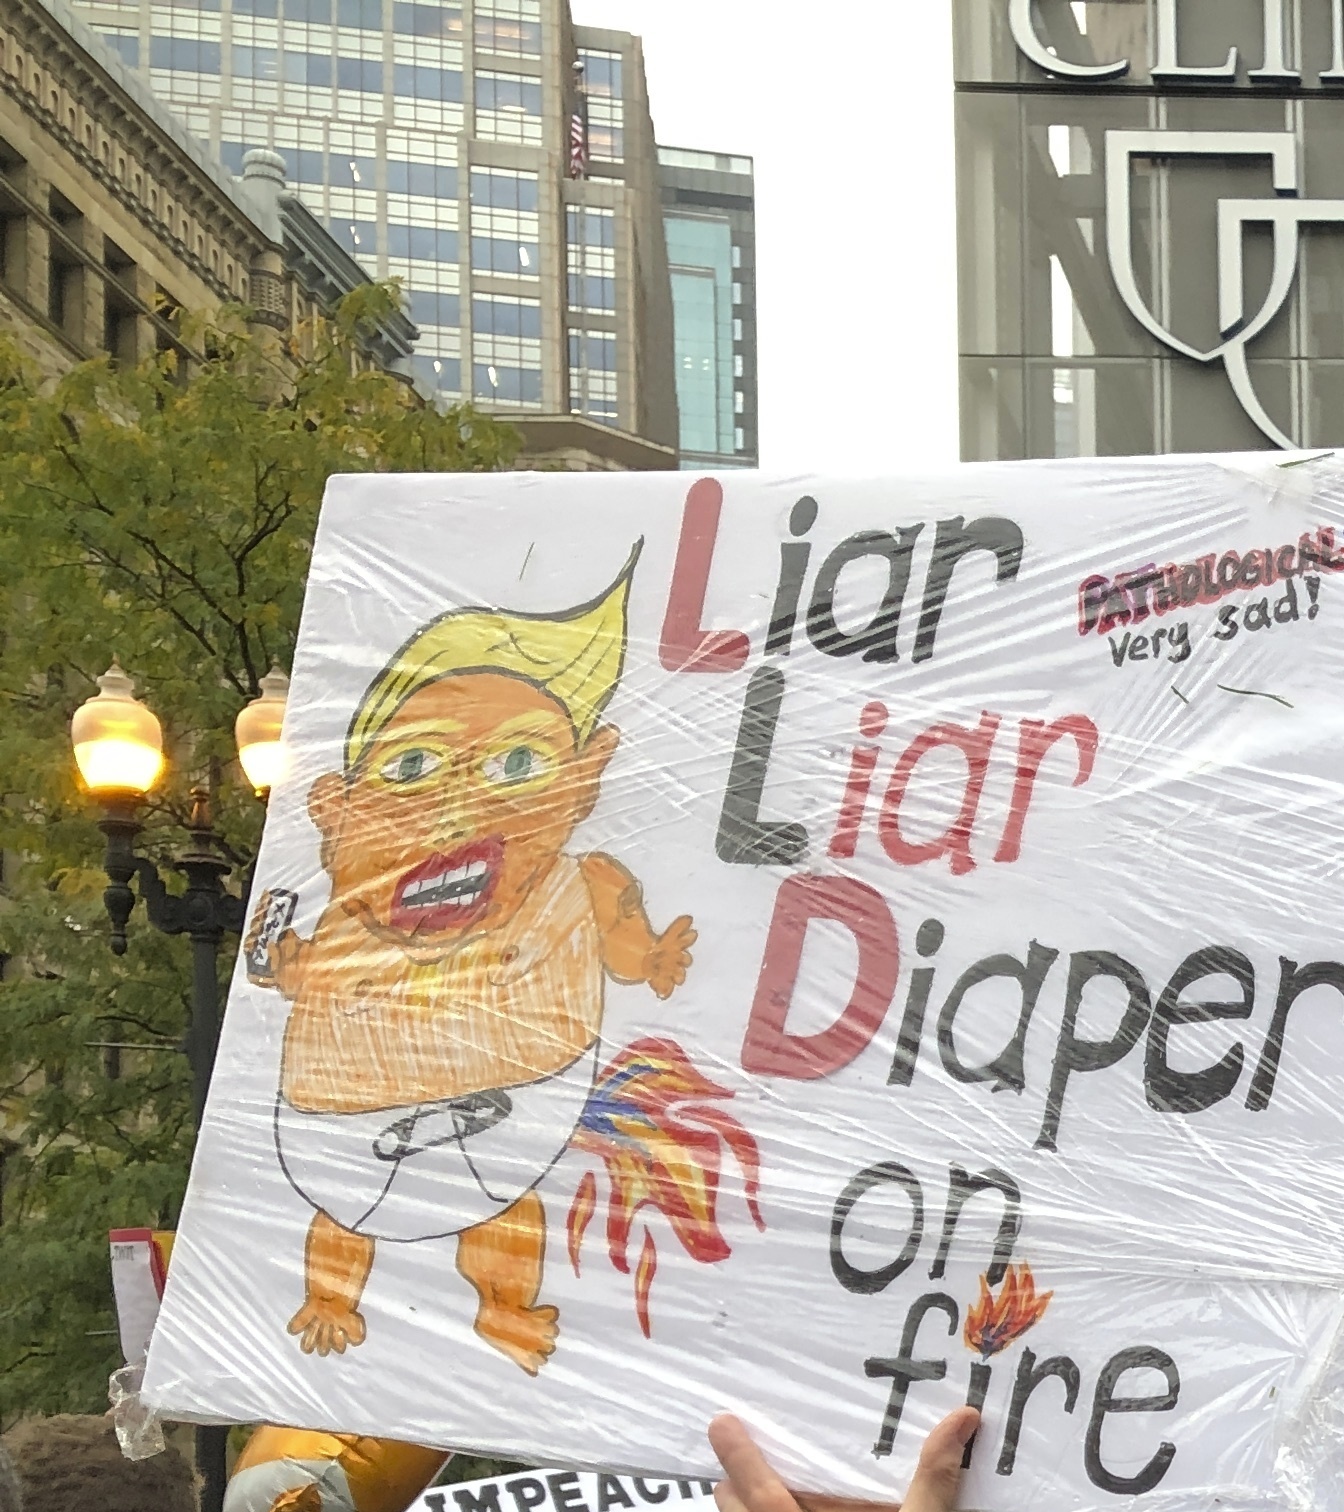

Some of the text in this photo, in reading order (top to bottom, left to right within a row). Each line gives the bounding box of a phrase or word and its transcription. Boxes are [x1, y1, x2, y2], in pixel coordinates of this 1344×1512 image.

[657, 476, 1025, 674] Liar
[1108, 574, 1321, 668] very sad!
[715, 664, 1099, 877] Liar
[829, 1160, 1023, 1296] on
[863, 1290, 1181, 1495] fire
